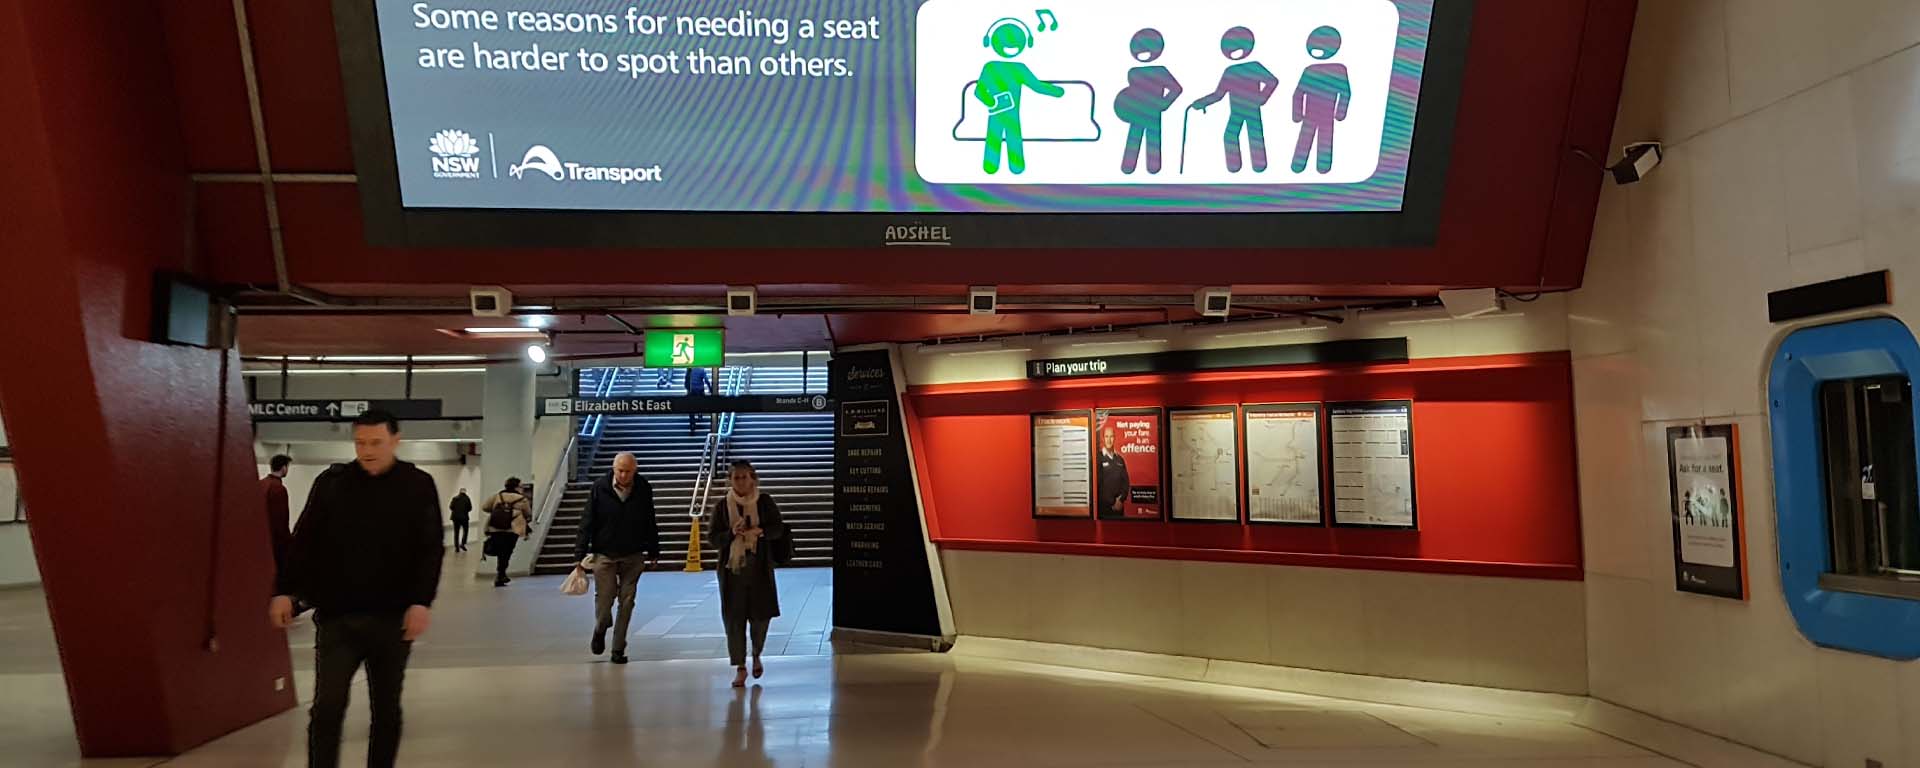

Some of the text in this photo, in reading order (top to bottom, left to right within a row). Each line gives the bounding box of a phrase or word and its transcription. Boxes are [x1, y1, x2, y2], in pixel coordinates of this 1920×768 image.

[412, 3, 880, 44] Some reasons for needing a seat
[418, 42, 853, 79] are harder to spot than others.
[432, 157, 480, 172] NSW
[564, 162, 662, 184] Transport
[885, 225, 952, 240] ADSHEL
[1046, 362, 1066, 373] Plan
[1067, 362, 1088, 375] your
[1089, 360, 1107, 373] trip
[247, 403, 319, 415] MLC Centre
[560, 401, 568, 411] 5
[574, 399, 629, 412] Elizabeth
[631, 399, 644, 411] St
[646, 399, 672, 411] East
[1117, 420, 1150, 430] Not paying
[1124, 430, 1137, 438] your
[1120, 443, 1156, 453] offence
[1692, 464, 1701, 472] for
